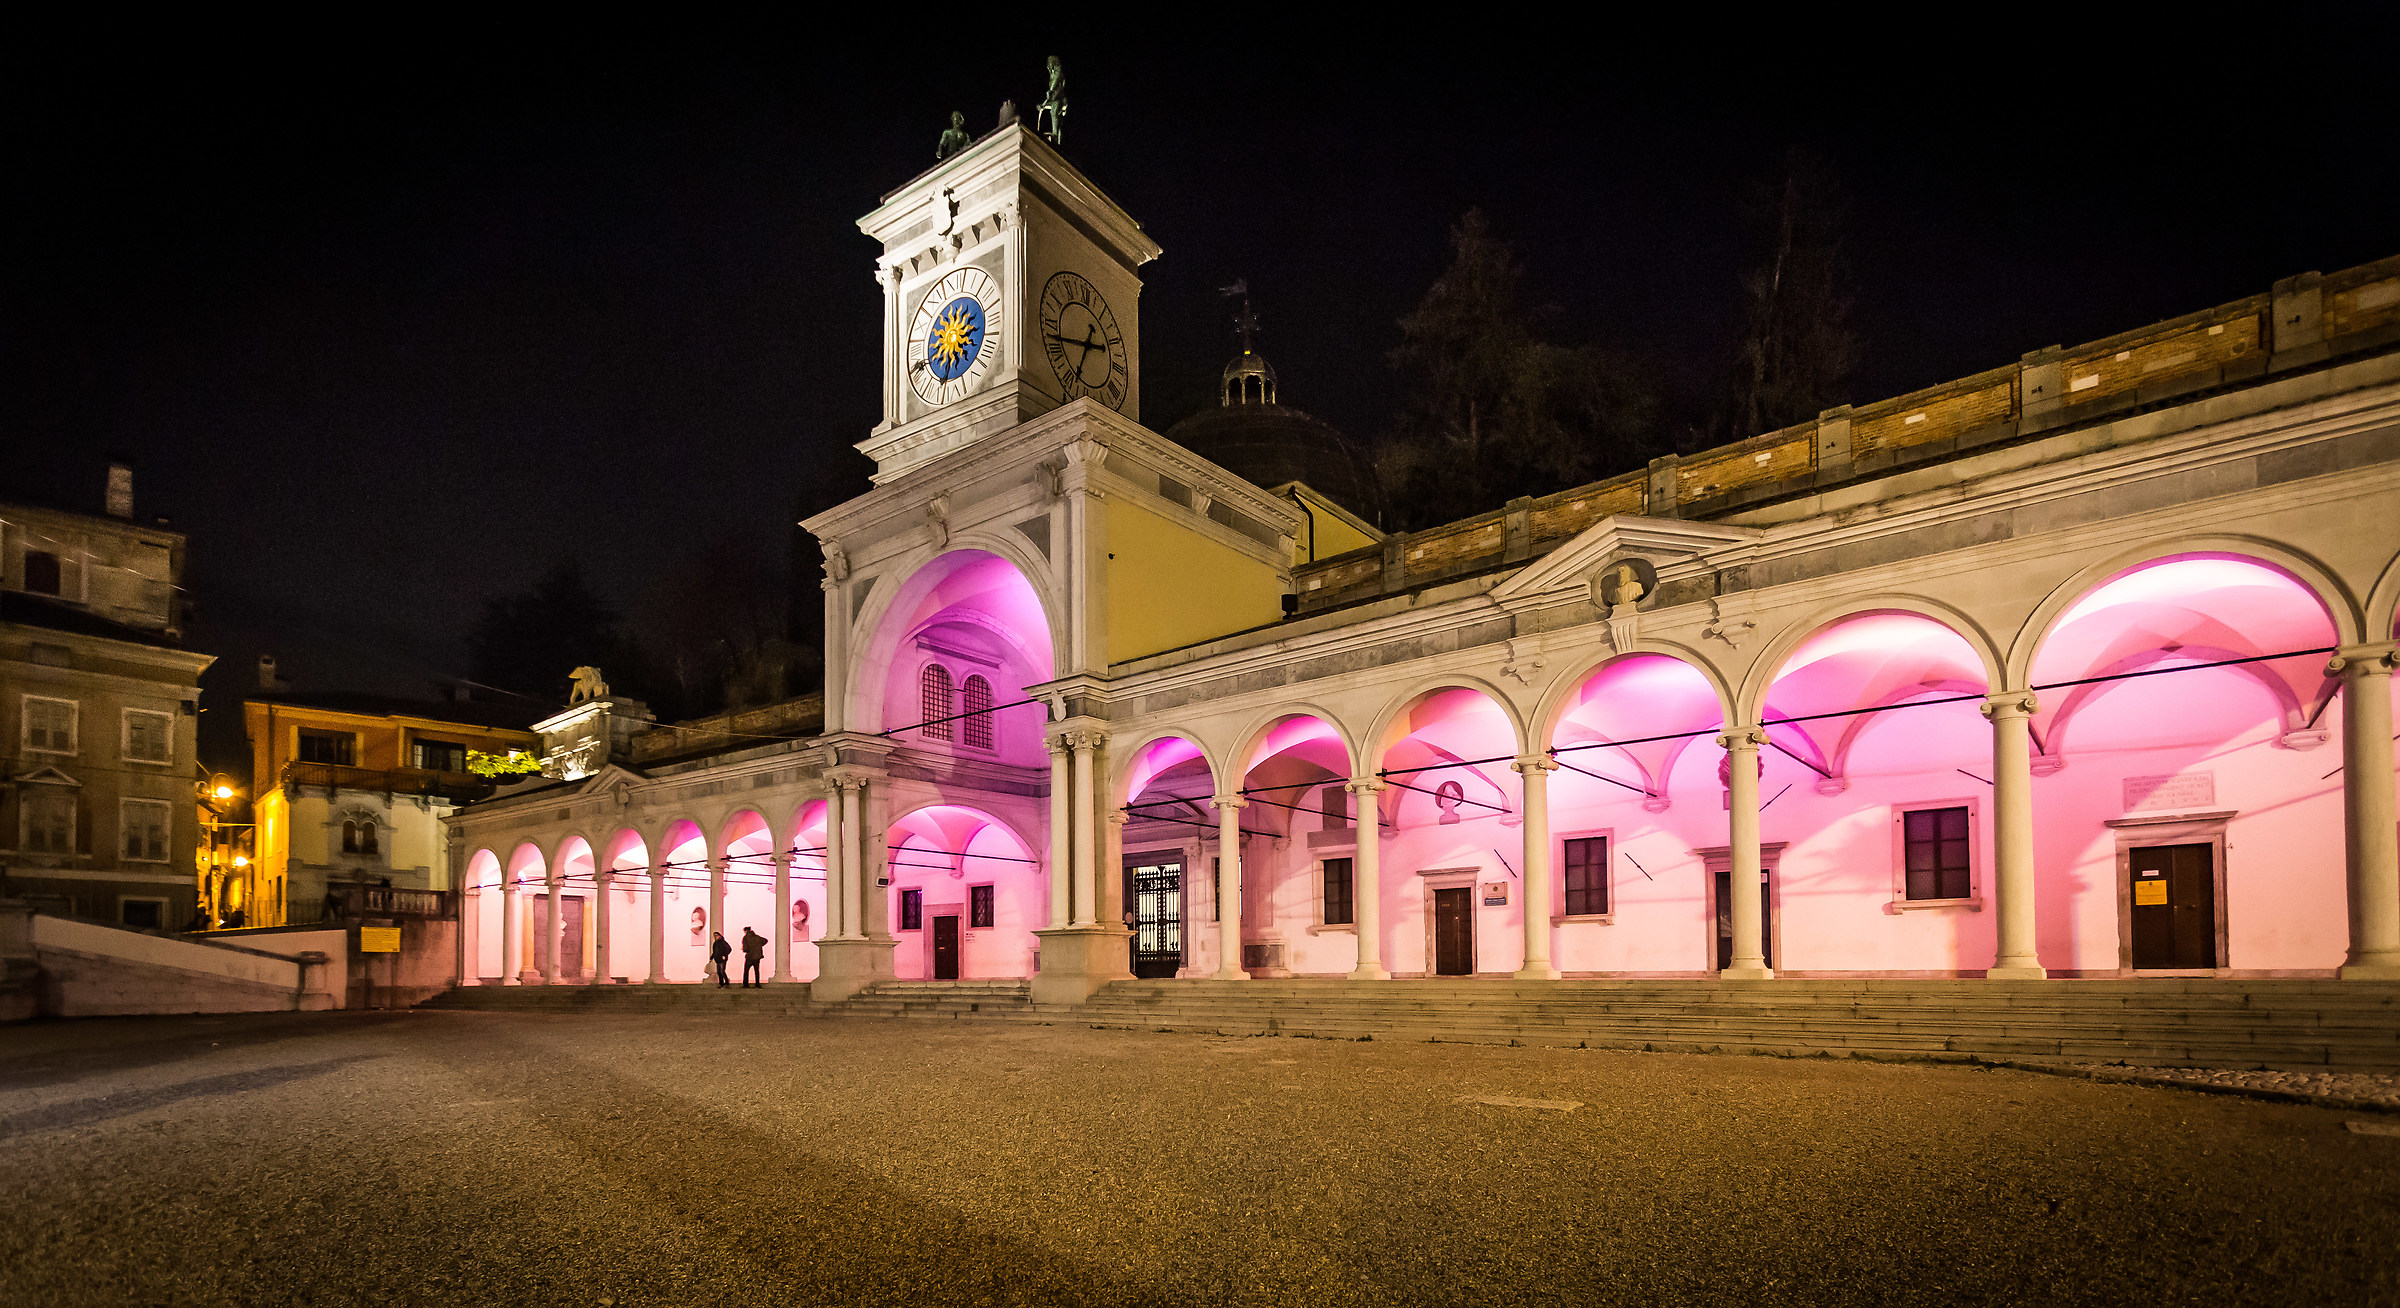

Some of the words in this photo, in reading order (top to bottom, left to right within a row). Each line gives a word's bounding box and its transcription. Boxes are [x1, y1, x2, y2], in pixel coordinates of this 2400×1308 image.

[982, 285, 995, 302] II
[914, 319, 928, 333] X
[987, 311, 1001, 327] III
[980, 339, 997, 359] IIII
[970, 370, 982, 388] V
